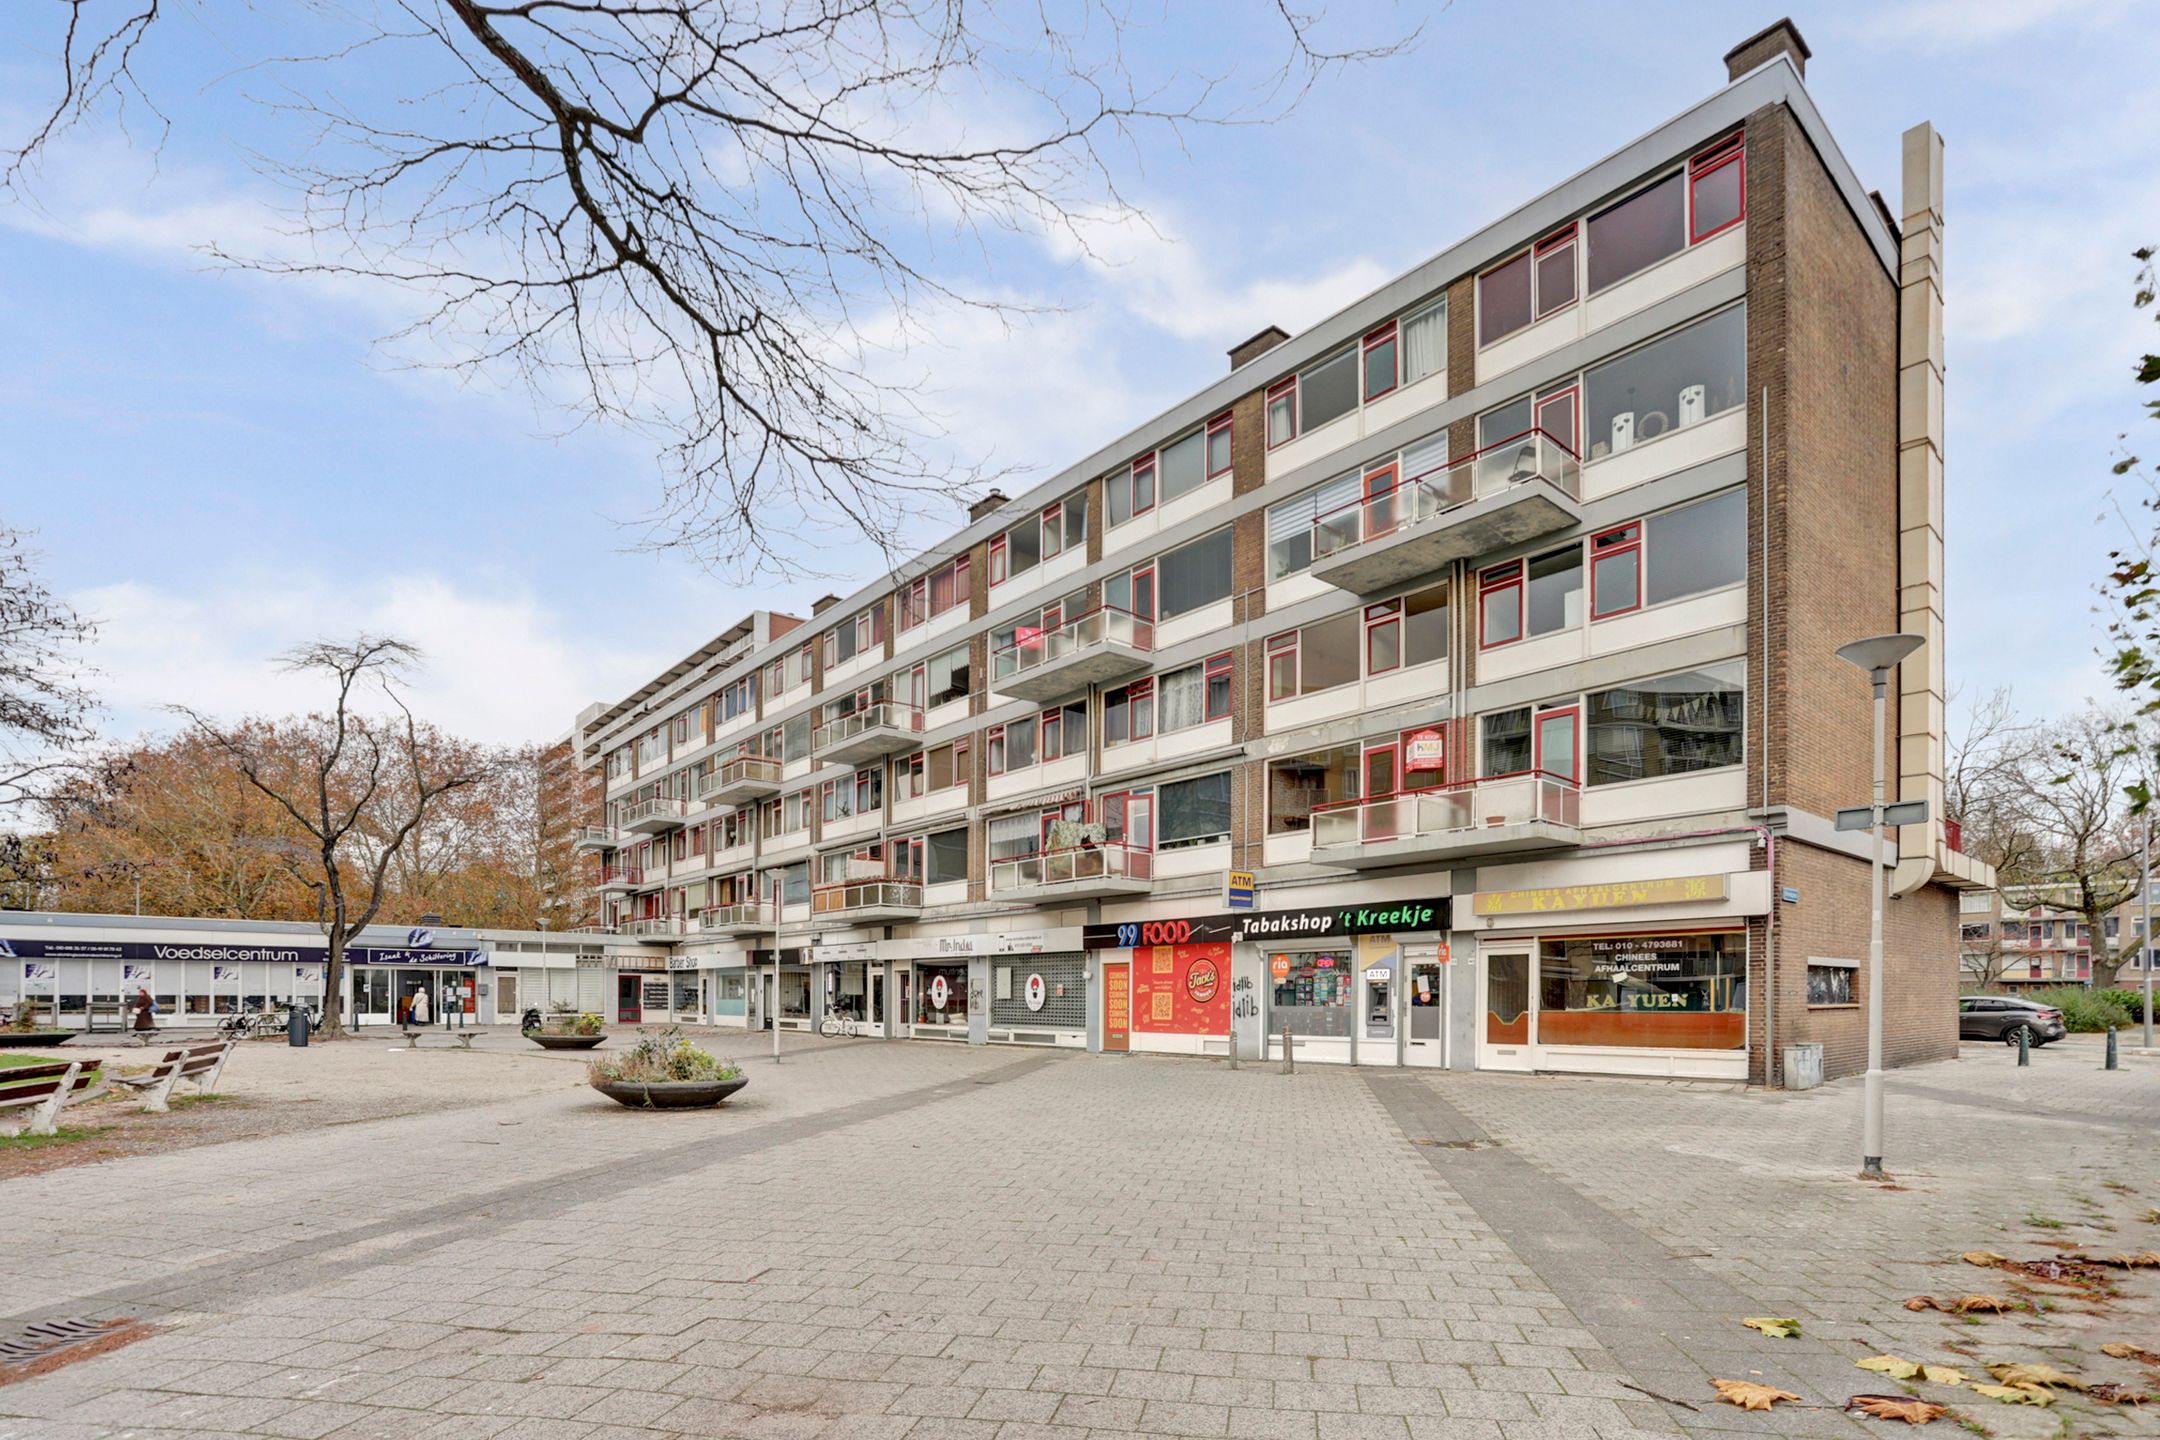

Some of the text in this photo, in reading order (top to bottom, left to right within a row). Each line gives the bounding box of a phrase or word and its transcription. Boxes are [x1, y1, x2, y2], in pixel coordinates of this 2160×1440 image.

[1231, 876, 1251, 887] ATM
[1242, 914, 1332, 934] Tabakshop
[1357, 905, 1433, 928] Kreekje
[1117, 920, 1191, 946] 99 FOOD
[1369, 935, 1392, 944] ATM
[1593, 943, 1613, 951] TEL:
[1615, 942, 1633, 950] 010
[153, 945, 299, 961] Voedselcentrum
[420, 952, 457, 963] Schittering
[1615, 952, 1658, 962] CHINEES
[685, 956, 698, 969] Shop
[1272, 957, 1289, 970] ria
[1594, 963, 1680, 973] AFHAALCENTRUM
[1369, 970, 1388, 978] ATM
[1108, 980, 1128, 991] SOON
[1108, 999, 1128, 1010] SOON
[1108, 1018, 1128, 1029] SOON
